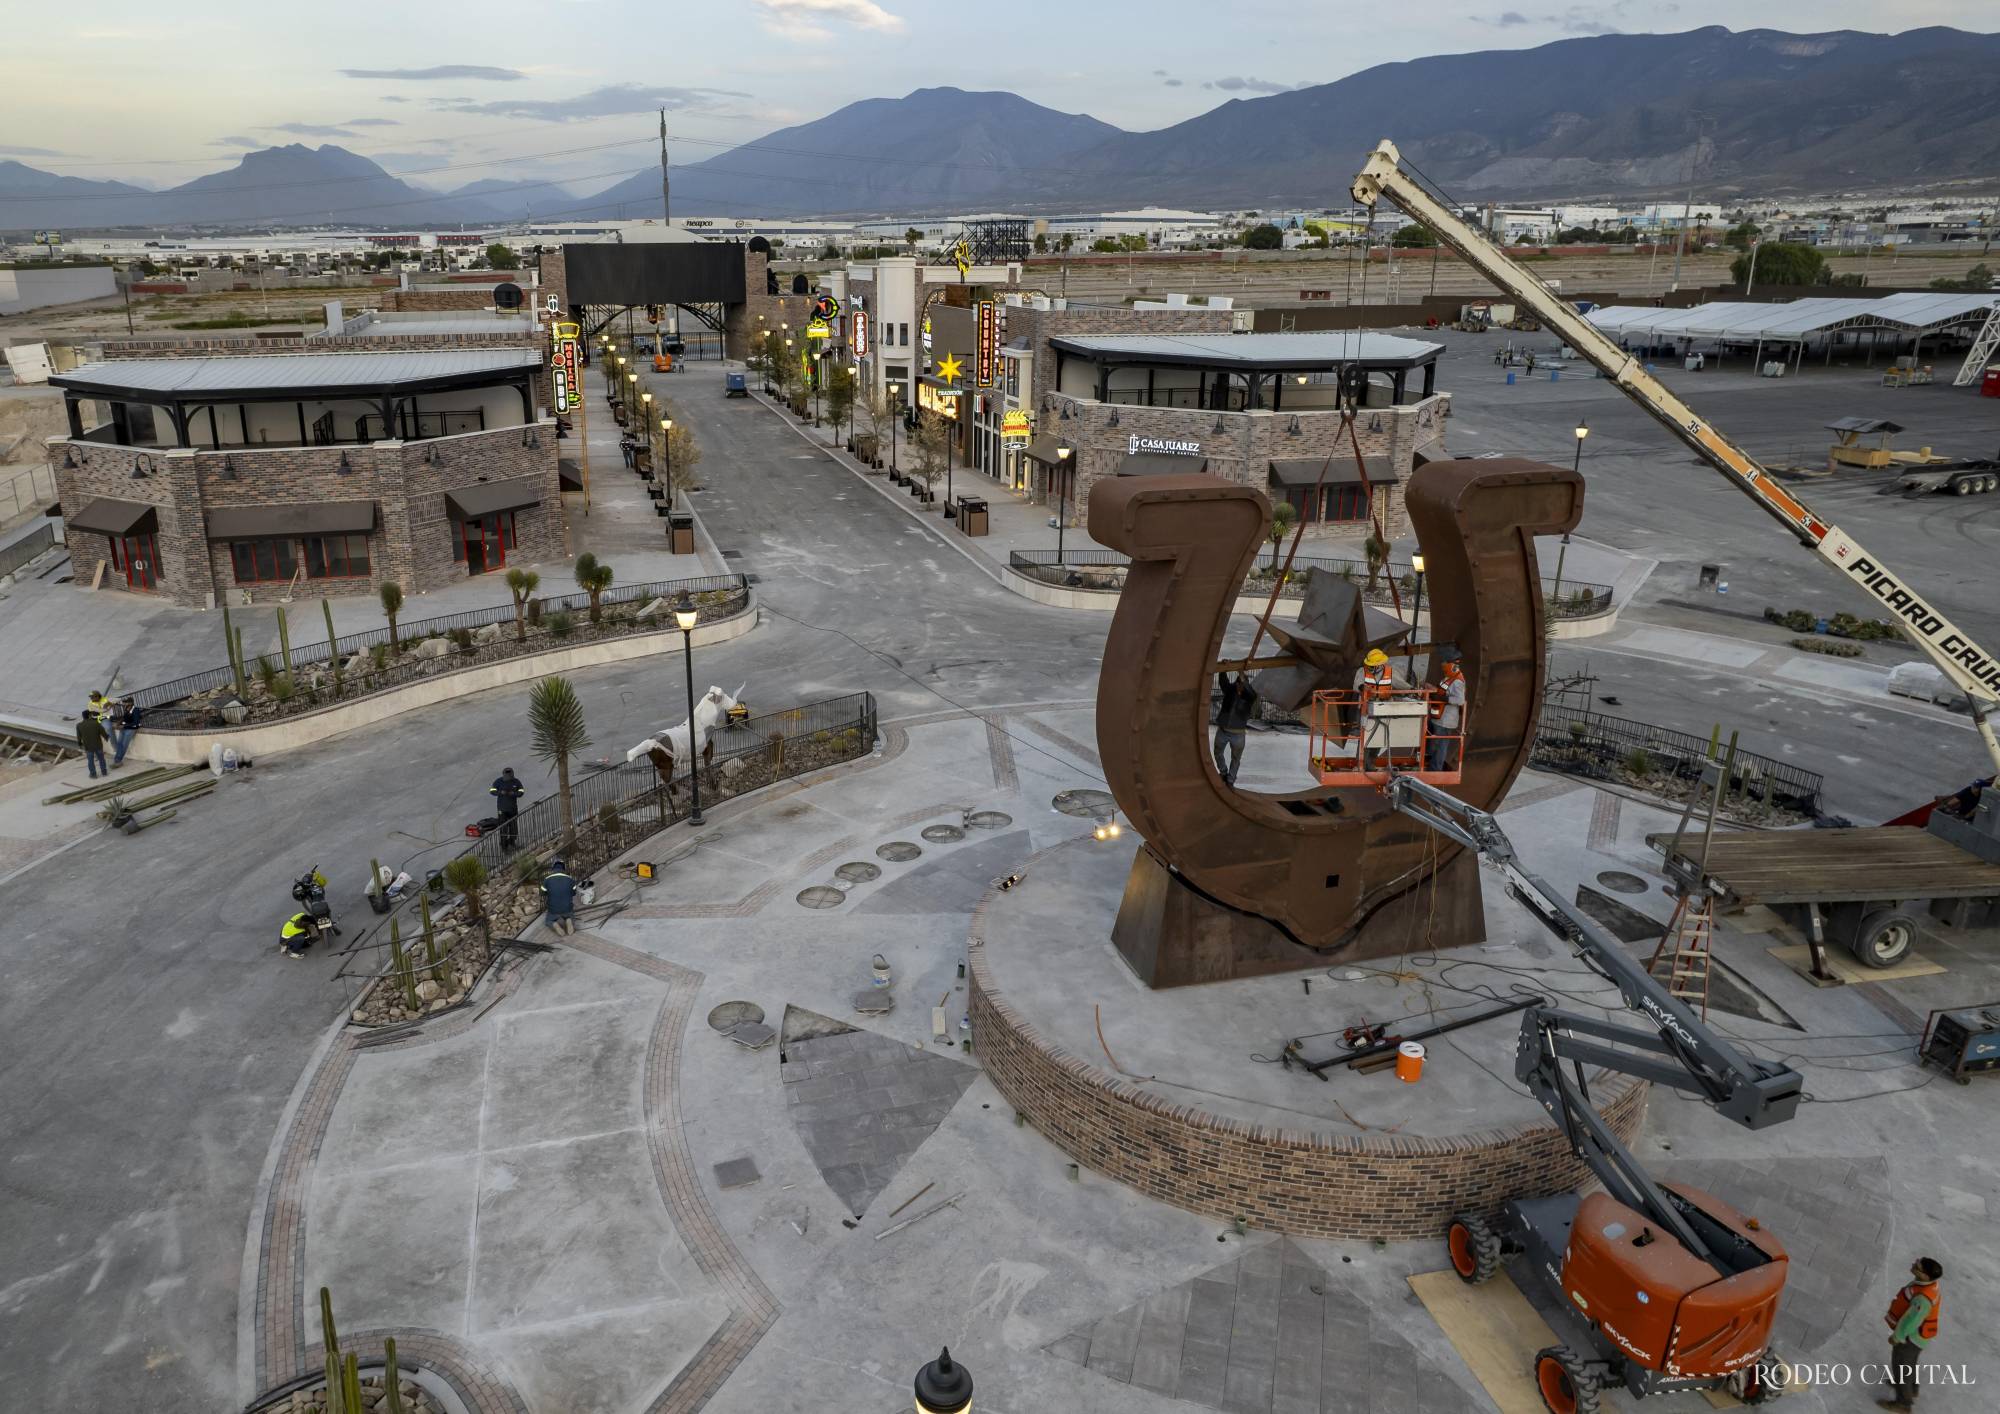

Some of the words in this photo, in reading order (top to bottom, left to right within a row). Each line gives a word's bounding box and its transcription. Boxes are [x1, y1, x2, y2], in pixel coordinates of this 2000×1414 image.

[856, 316, 865, 352] SALOON
[982, 309, 990, 377] COUNTRY
[1141, 439, 1164, 449] CASA
[1164, 441, 1200, 452] JUAREZ
[1687, 420, 1701, 434] 35
[1801, 515, 1812, 527] 53
[1847, 557, 1945, 636] PICARO
[1939, 635, 2000, 695] GRUA
[1642, 995, 1698, 1049] SKYJACK
[1604, 1321, 1652, 1360] SKYJACK
